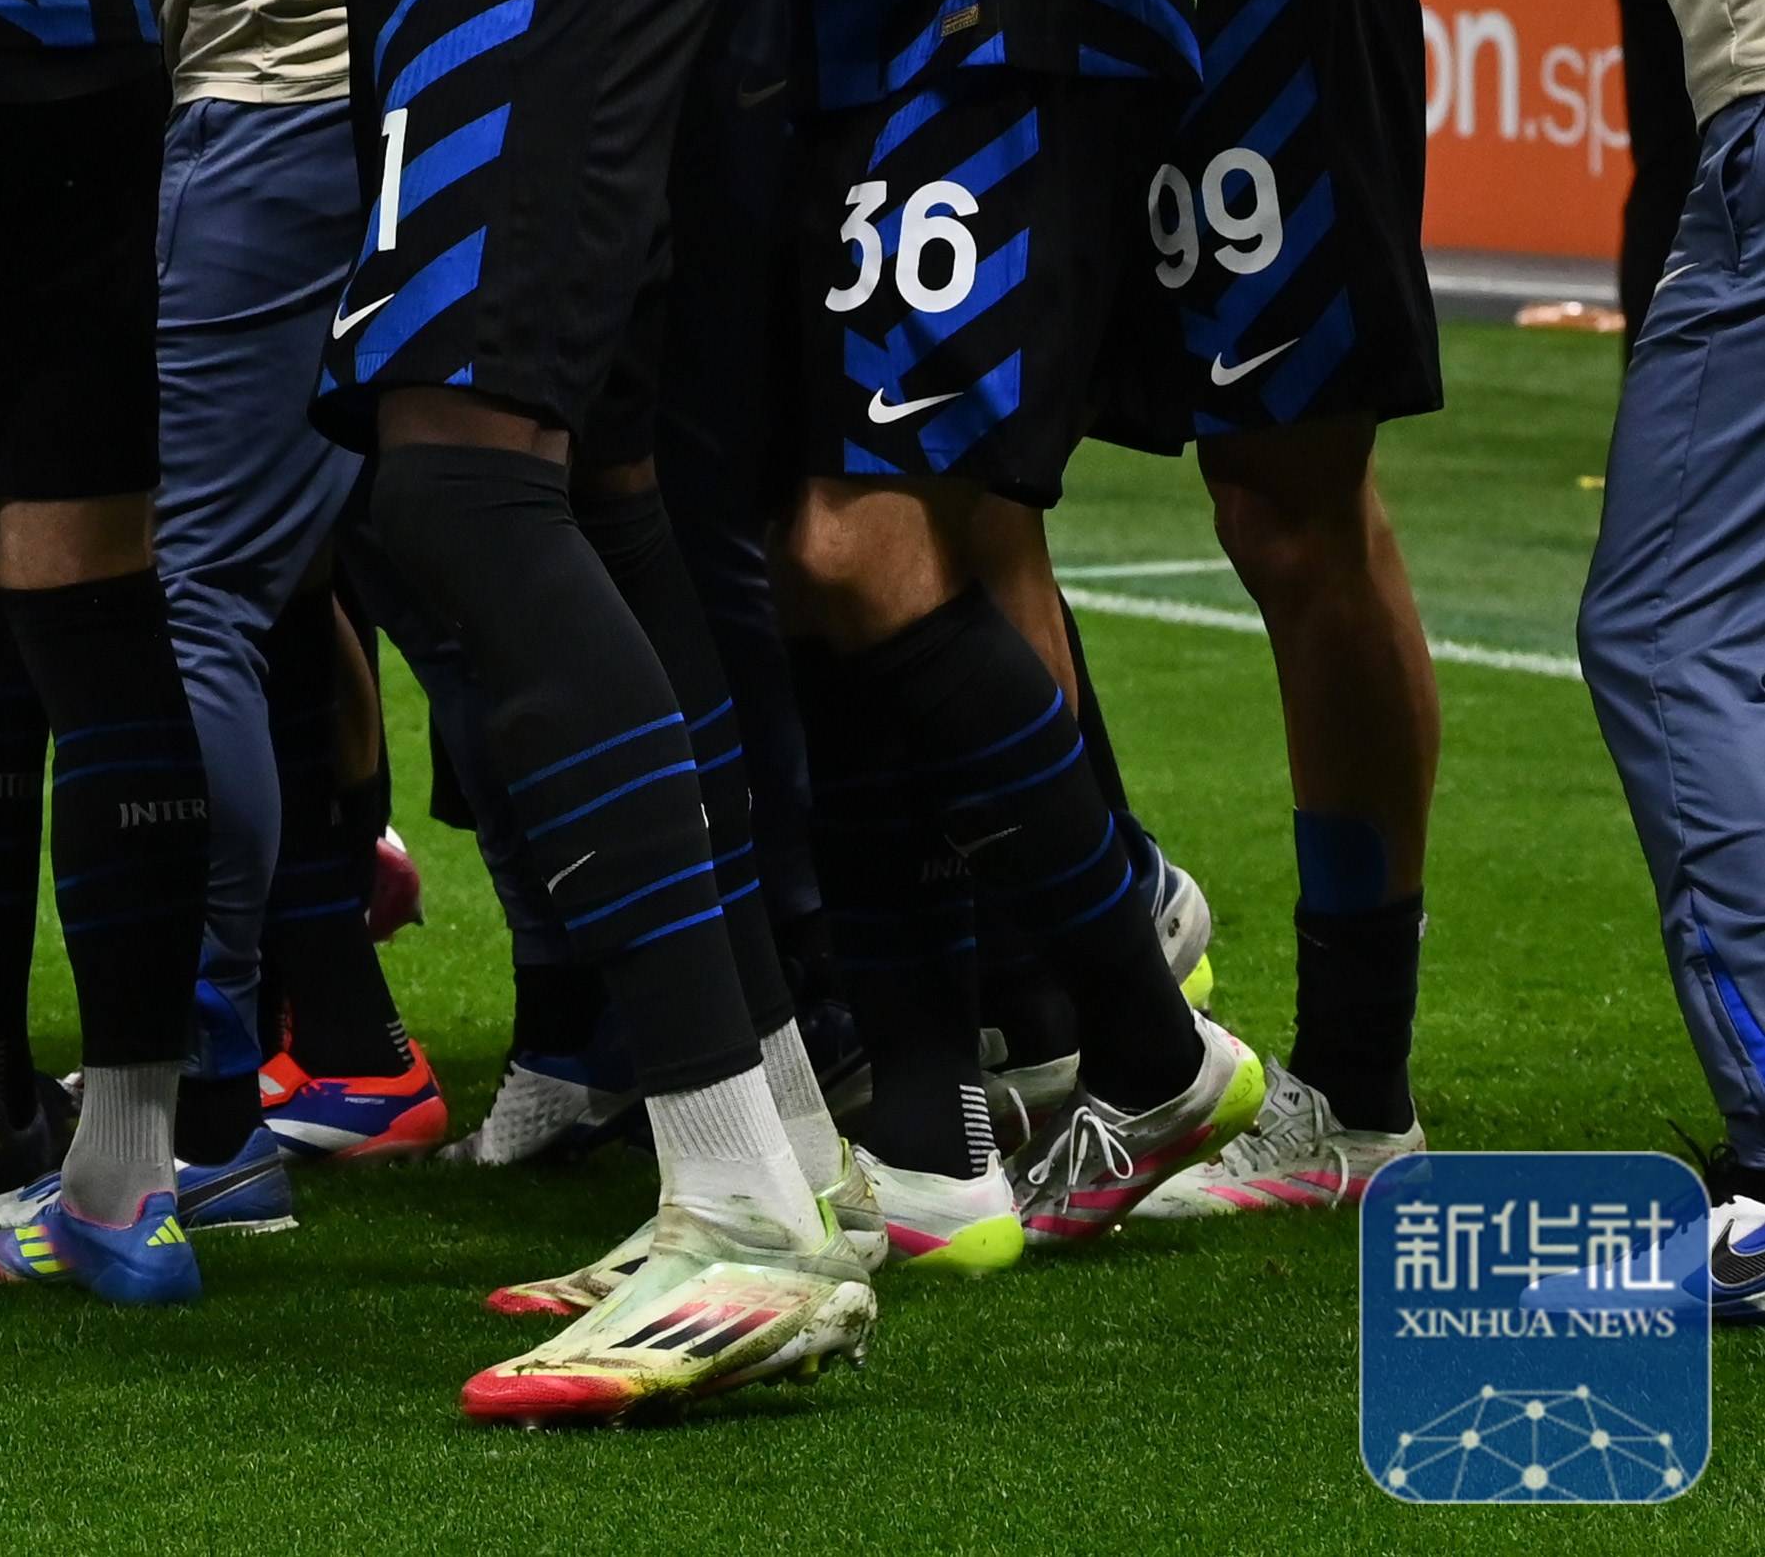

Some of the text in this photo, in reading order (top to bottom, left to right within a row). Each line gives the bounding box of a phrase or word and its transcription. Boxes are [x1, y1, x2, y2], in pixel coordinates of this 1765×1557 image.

[824, 179, 980, 313] 36
[1147, 147, 1284, 290] 99
[118, 796, 208, 829] INTER
